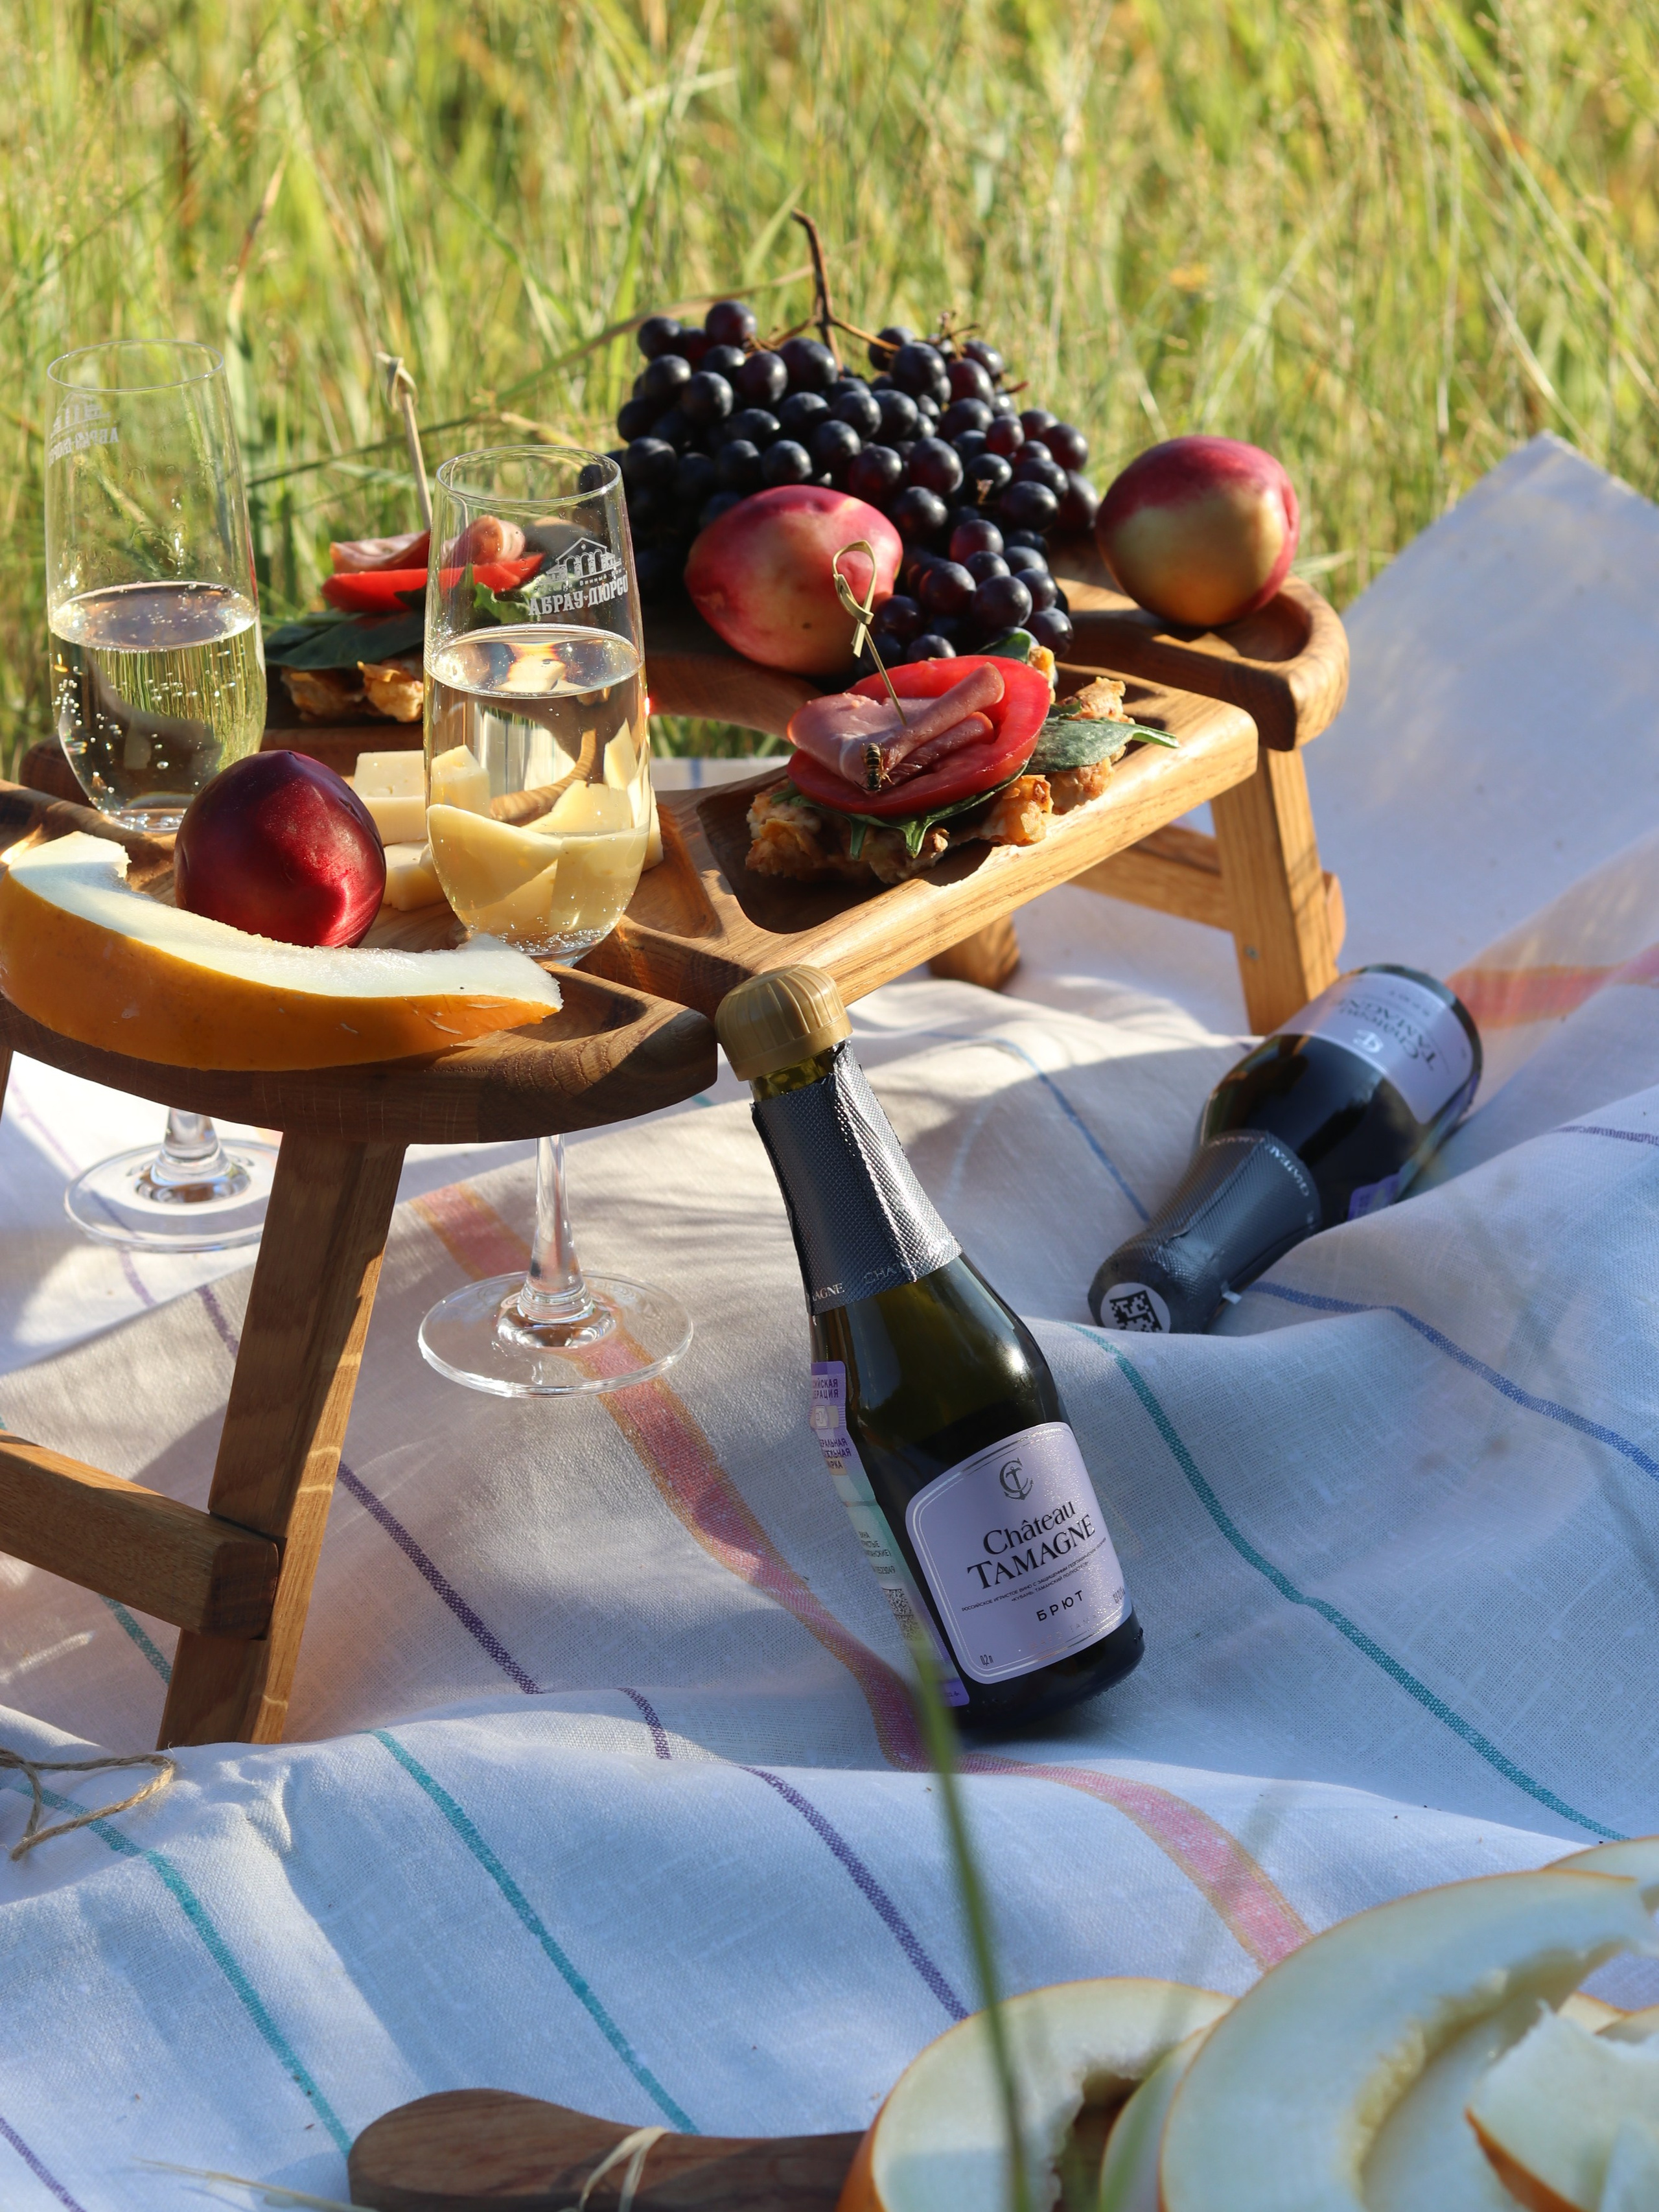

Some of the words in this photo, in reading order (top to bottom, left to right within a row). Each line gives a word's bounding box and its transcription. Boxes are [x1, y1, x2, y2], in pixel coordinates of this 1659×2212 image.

[813, 1389, 839, 1400] ЕРАЦИЯ
[982, 1501, 1076, 1555] Château
[966, 1513, 1096, 1590] TAMAGNE
[961, 1598, 993, 1612] РОССИЙСКОЕ
[993, 1590, 1019, 1602] ИГРИСТОЕ
[1019, 1583, 1032, 1593] ВИНО
[1034, 1575, 1063, 1592] ТАМАНСКИЙ
[1036, 1589, 1083, 1622] БРЮТ
